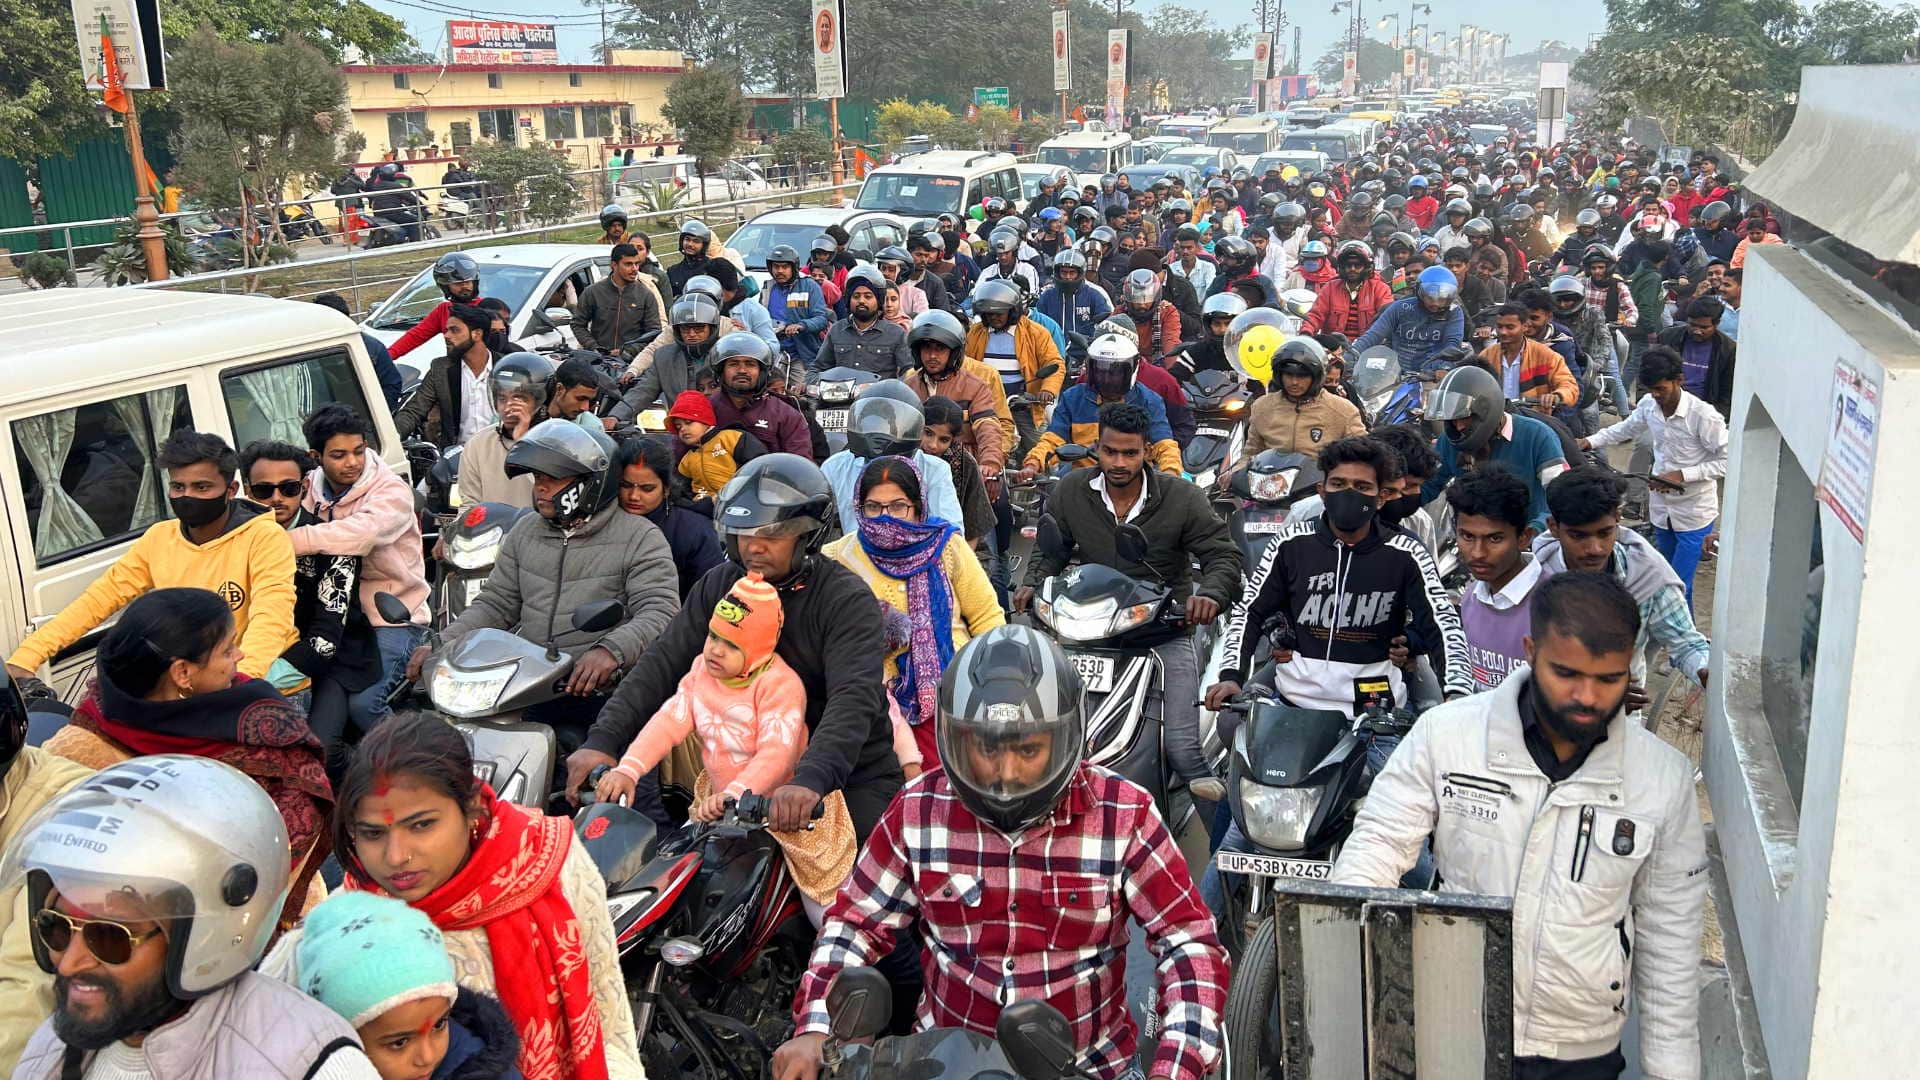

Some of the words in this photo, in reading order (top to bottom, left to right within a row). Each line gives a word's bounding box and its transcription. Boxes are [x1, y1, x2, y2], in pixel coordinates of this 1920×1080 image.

[453, 23, 476, 41] आदर्श
[478, 23, 500, 46] पुलिस
[1481, 649, 1505, 672] POLO
[1470, 805, 1498, 820] 3310
[1231, 857, 1248, 870] UP
[1254, 859, 1289, 876] 53BX
[1295, 863, 1332, 879] 2457
